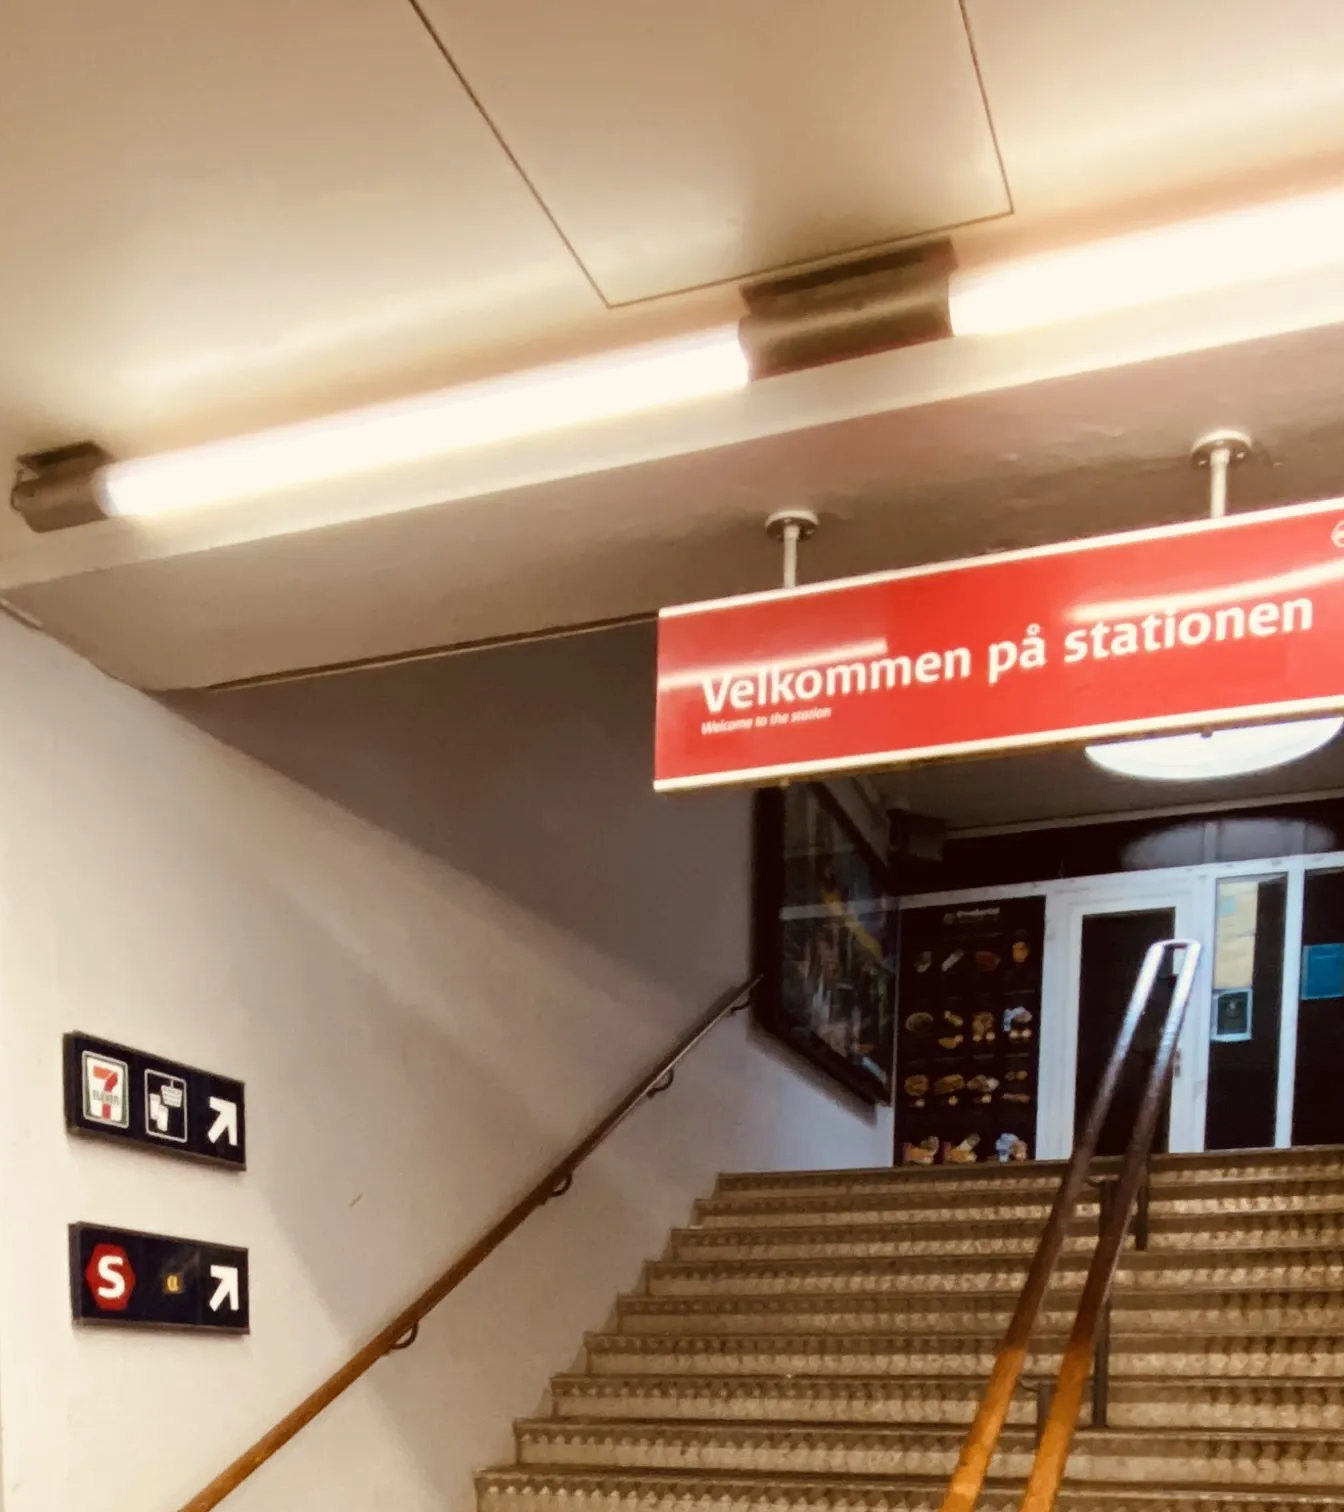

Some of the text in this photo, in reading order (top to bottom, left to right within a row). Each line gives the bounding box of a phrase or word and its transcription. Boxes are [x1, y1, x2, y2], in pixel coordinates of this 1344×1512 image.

[702, 598, 1313, 713] Velkommen på stationen
[701, 718, 752, 735] Welcome
[770, 711, 789, 726] the
[791, 707, 832, 722] station
[93, 1065, 118, 1120] 7
[97, 1255, 125, 1299] S
